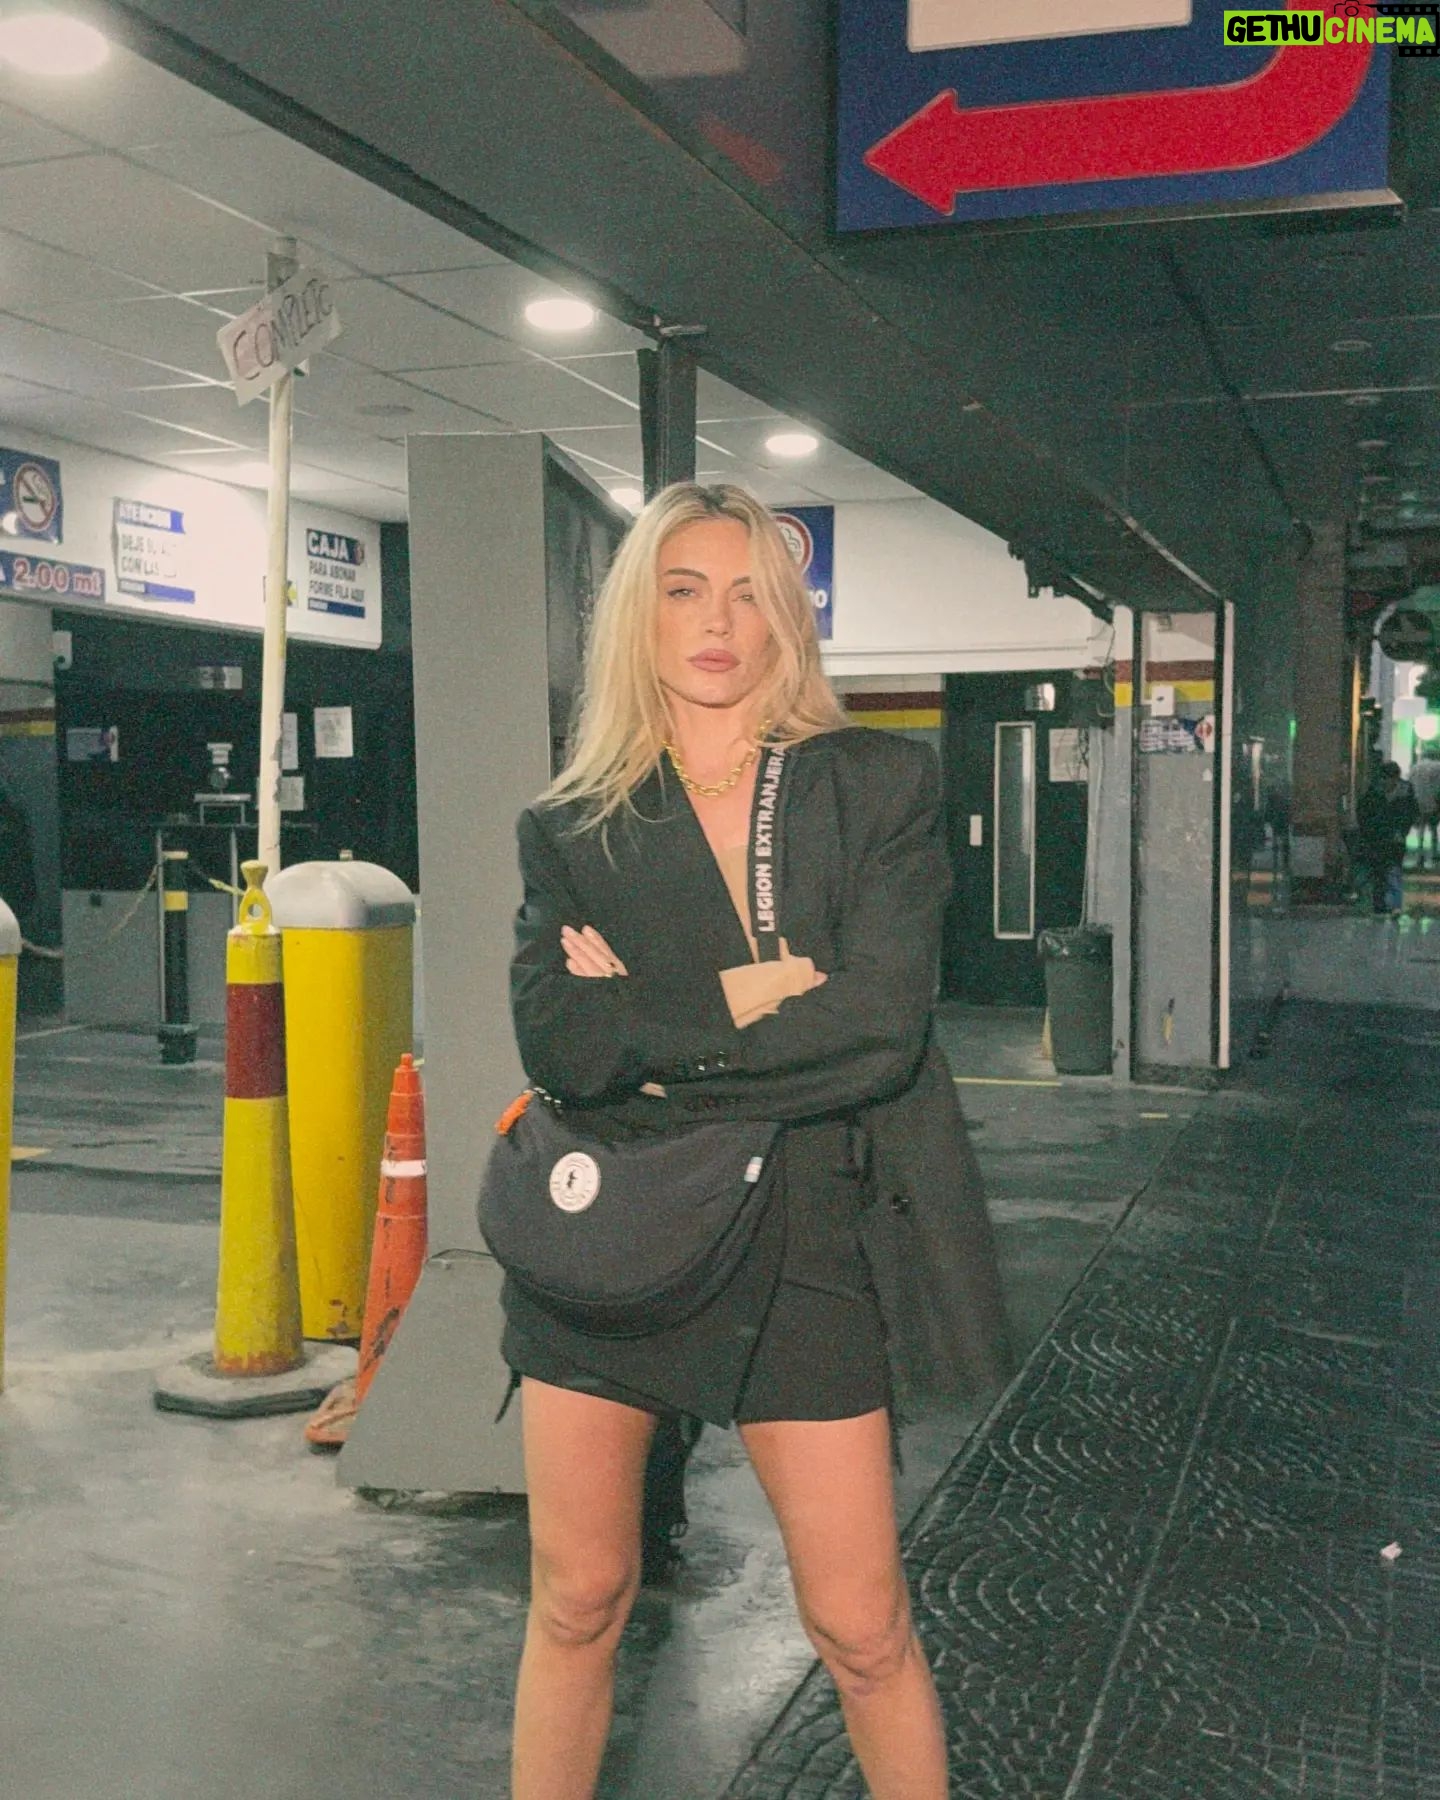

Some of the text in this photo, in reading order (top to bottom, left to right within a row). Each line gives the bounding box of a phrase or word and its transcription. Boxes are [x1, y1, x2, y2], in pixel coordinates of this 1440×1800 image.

[308, 531, 349, 560] CAJA
[12, 557, 70, 593] 2.00
[309, 560, 327, 576] PARA
[755, 865, 776, 932] LEGION
